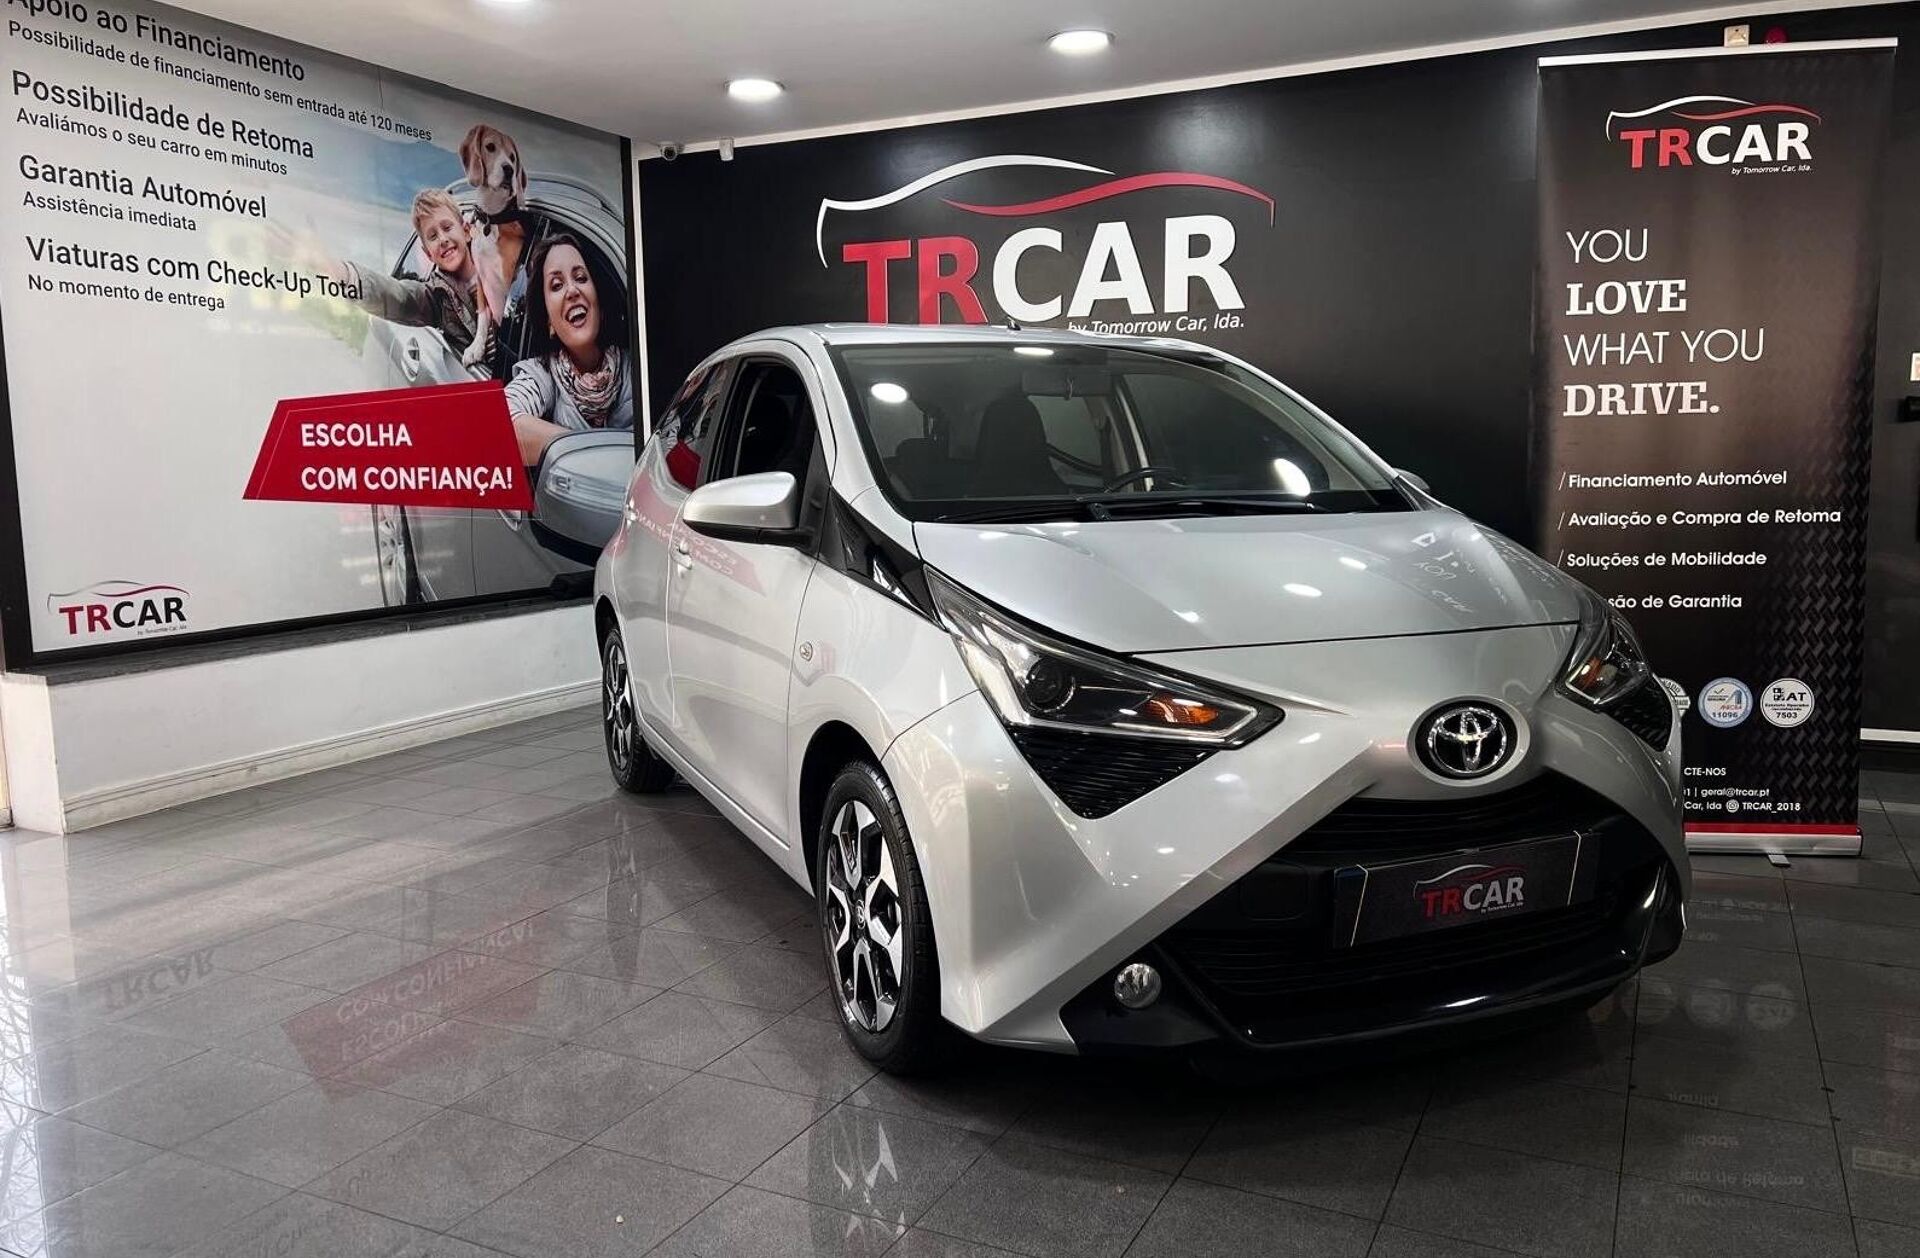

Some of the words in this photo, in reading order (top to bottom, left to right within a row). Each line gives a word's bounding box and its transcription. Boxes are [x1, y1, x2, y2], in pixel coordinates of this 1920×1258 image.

[7, 0, 88, 22] poio
[97, 9, 128, 33] ao
[136, 14, 304, 81] Financiamento
[9, 20, 125, 63] Possibilidade
[129, 51, 150, 69] de
[154, 56, 260, 97] financiamento
[264, 90, 293, 106] sem
[296, 97, 345, 119] entrada
[348, 110, 368, 126] até
[371, 114, 392, 131] 120
[394, 121, 433, 141] meses
[12, 70, 190, 131] Possibilidade
[196, 112, 225, 138] de
[231, 119, 314, 158] Retoma
[16, 107, 107, 139] Avaliámos
[112, 129, 122, 142] o
[127, 132, 156, 148] seu
[160, 138, 200, 157] carro
[204, 147, 227, 163] em
[231, 153, 287, 175] minutos
[1620, 122, 1812, 169] TRCAR
[19, 154, 134, 196] Garantia
[142, 176, 266, 218] Automóvel
[1731, 167, 1742, 176] by
[1743, 166, 1780, 175] Tomorrow
[23, 191, 123, 220] Assistência
[128, 206, 196, 231] imediata
[1566, 228, 1648, 263] YOU
[26, 235, 139, 273] Viaturas
[147, 257, 199, 280] com
[207, 260, 311, 298] Check-Up
[316, 275, 363, 300] Total
[842, 214, 1246, 327] TRCAR
[28, 274, 53, 292] No
[59, 280, 139, 300] momento
[145, 286, 164, 303] de
[168, 291, 225, 312] entrega
[1566, 279, 1687, 315] LOVE
[1091, 319, 1171, 334] Tomorrow
[1176, 315, 1207, 333] Car,
[1563, 331, 1670, 366] WHAT
[1681, 328, 1764, 362] YOU
[1563, 381, 1720, 416] DRIVE.
[301, 423, 412, 447] ESCOLHA
[301, 467, 357, 491] COM
[364, 466, 512, 496] CONFIANÇA!
[1568, 473, 1692, 488] Financiamento
[1696, 470, 1787, 486] Automóvel
[1568, 511, 1651, 529] Avaliação
[1656, 515, 1667, 525] e
[1672, 510, 1742, 527] Compra
[1747, 509, 1770, 524] de
[1775, 508, 1841, 524] Retoma
[1567, 552, 1639, 571] Soluções
[1644, 551, 1666, 566] de
[1671, 551, 1767, 566] Mobilidade
[58, 597, 187, 635] TRCAR
[1608, 594, 1637, 609] são
[1641, 594, 1664, 608] de
[1668, 594, 1742, 608] Garantia
[1776, 711, 1798, 719] 7503
[1684, 767, 1726, 776] CTE-NOS
[1701, 787, 1770, 798] geral@trcar.pt
[1742, 802, 1801, 814] TRCAR_2018
[1422, 876, 1525, 918] TRCAR
